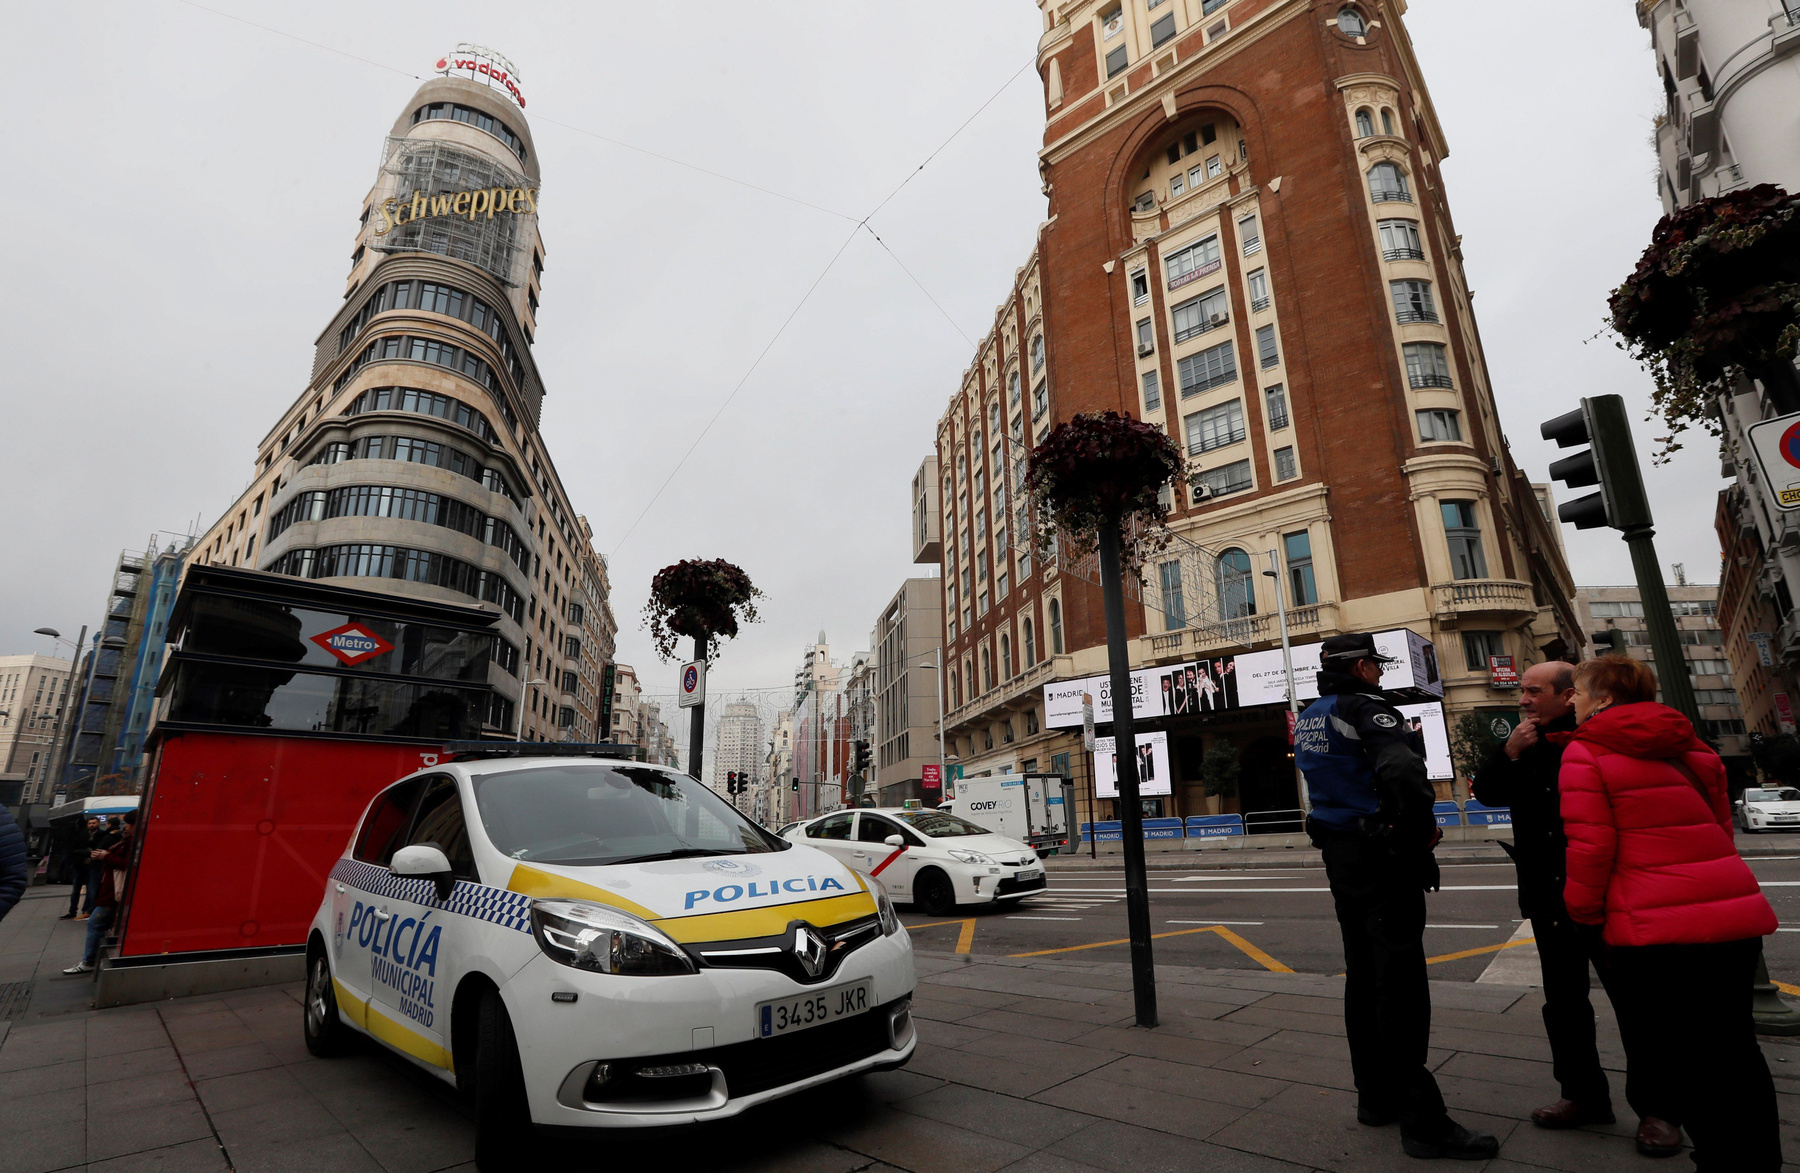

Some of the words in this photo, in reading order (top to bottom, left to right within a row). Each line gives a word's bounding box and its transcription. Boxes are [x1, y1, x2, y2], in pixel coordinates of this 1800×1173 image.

[455, 59, 526, 109] vodafone
[375, 186, 538, 236] Schweppes
[333, 636, 373, 650] Metro
[603, 667, 613, 715] HOTEL
[1207, 827, 1233, 835] MADRID
[683, 873, 845, 911] POLICÍA
[346, 900, 443, 978] POLICÍA
[372, 955, 435, 1009] MUNICIPAL
[399, 995, 435, 1029] MADRID
[776, 995, 828, 1031] 3435
[834, 985, 867, 1017] JKR
